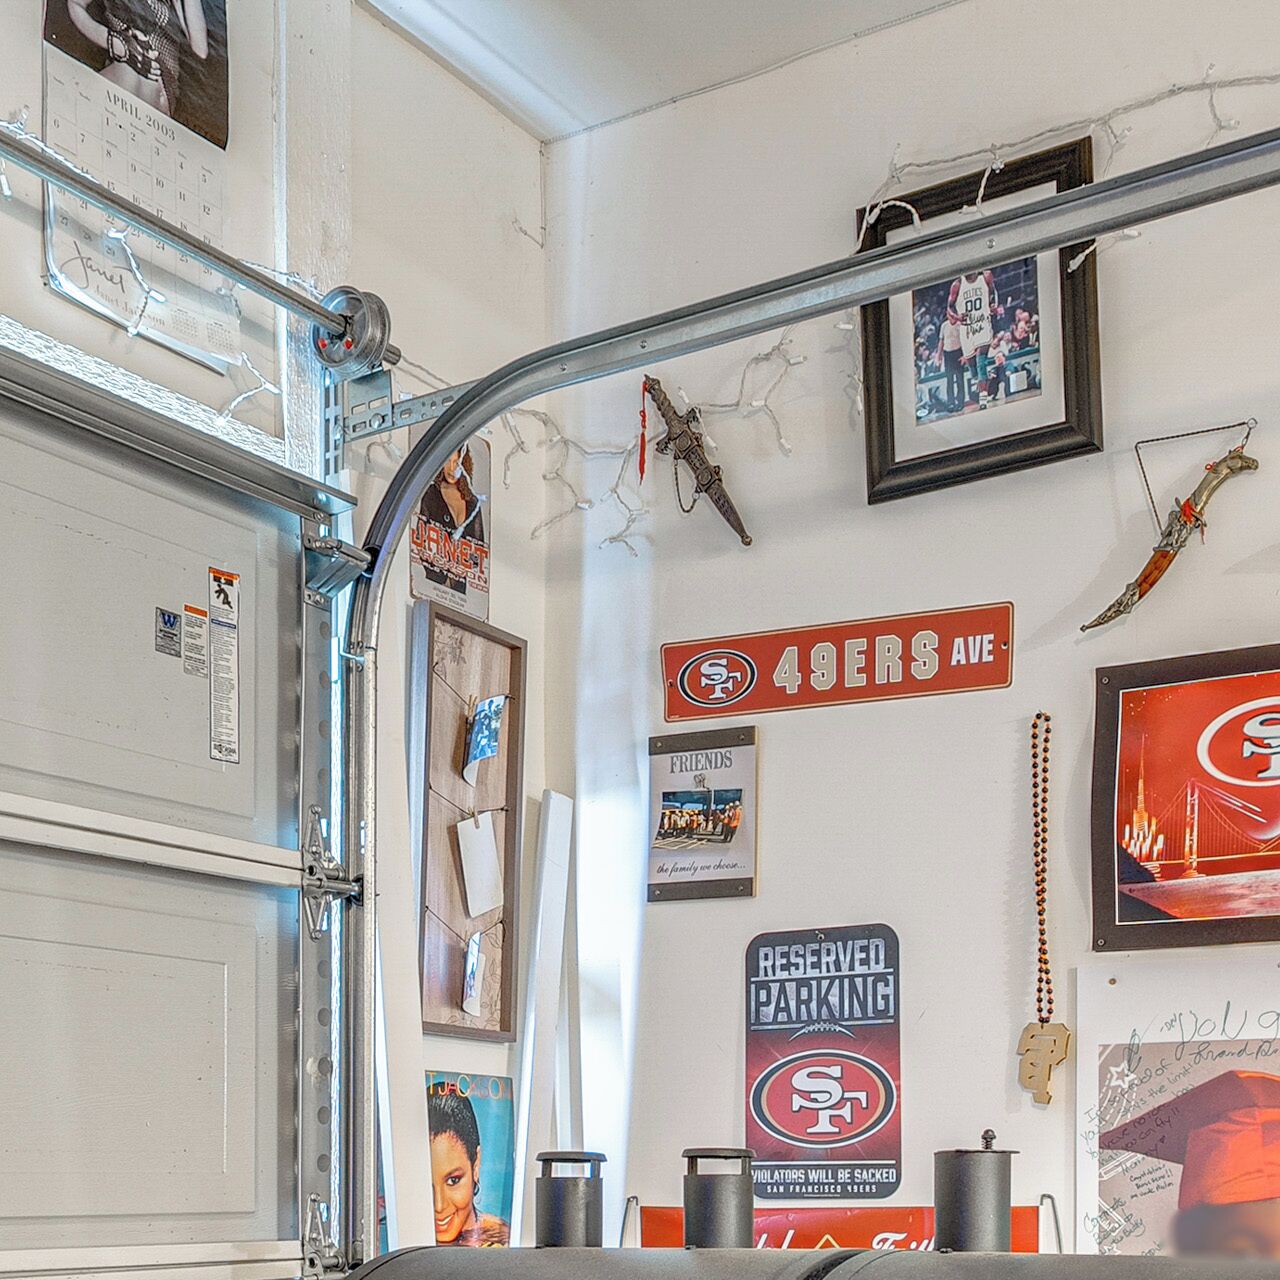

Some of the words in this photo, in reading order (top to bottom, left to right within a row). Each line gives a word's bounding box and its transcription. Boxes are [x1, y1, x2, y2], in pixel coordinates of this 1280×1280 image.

[106, 90, 141, 121] APRIL
[146, 114, 176, 141] 2003
[53, 118, 60, 129] 6
[80, 133, 86, 143] 7
[106, 149, 111, 158] 8
[156, 177, 164, 189] 10
[203, 204, 211, 216] 12
[156, 239, 165, 252] 24
[965, 298, 982, 312] 00
[411, 520, 488, 575] JANET
[772, 630, 941, 694] 49ERS
[950, 633, 995, 667] AVE
[670, 750, 732, 774] FRIENDS
[657, 863, 669, 874] the
[669, 861, 698, 877] family
[758, 938, 887, 978] RESERVED
[751, 976, 894, 1022] PARKING
[790, 1064, 868, 1134] SF
[751, 1170, 805, 1183] VIOLATORS
[807, 1169, 835, 1182] WILL
[838, 1169, 851, 1182] BE
[854, 1168, 896, 1182] SACKED
[767, 1185, 784, 1193] SAN
[790, 1185, 841, 1193] FRANCISCO
[847, 1185, 877, 1193] 49ERS
